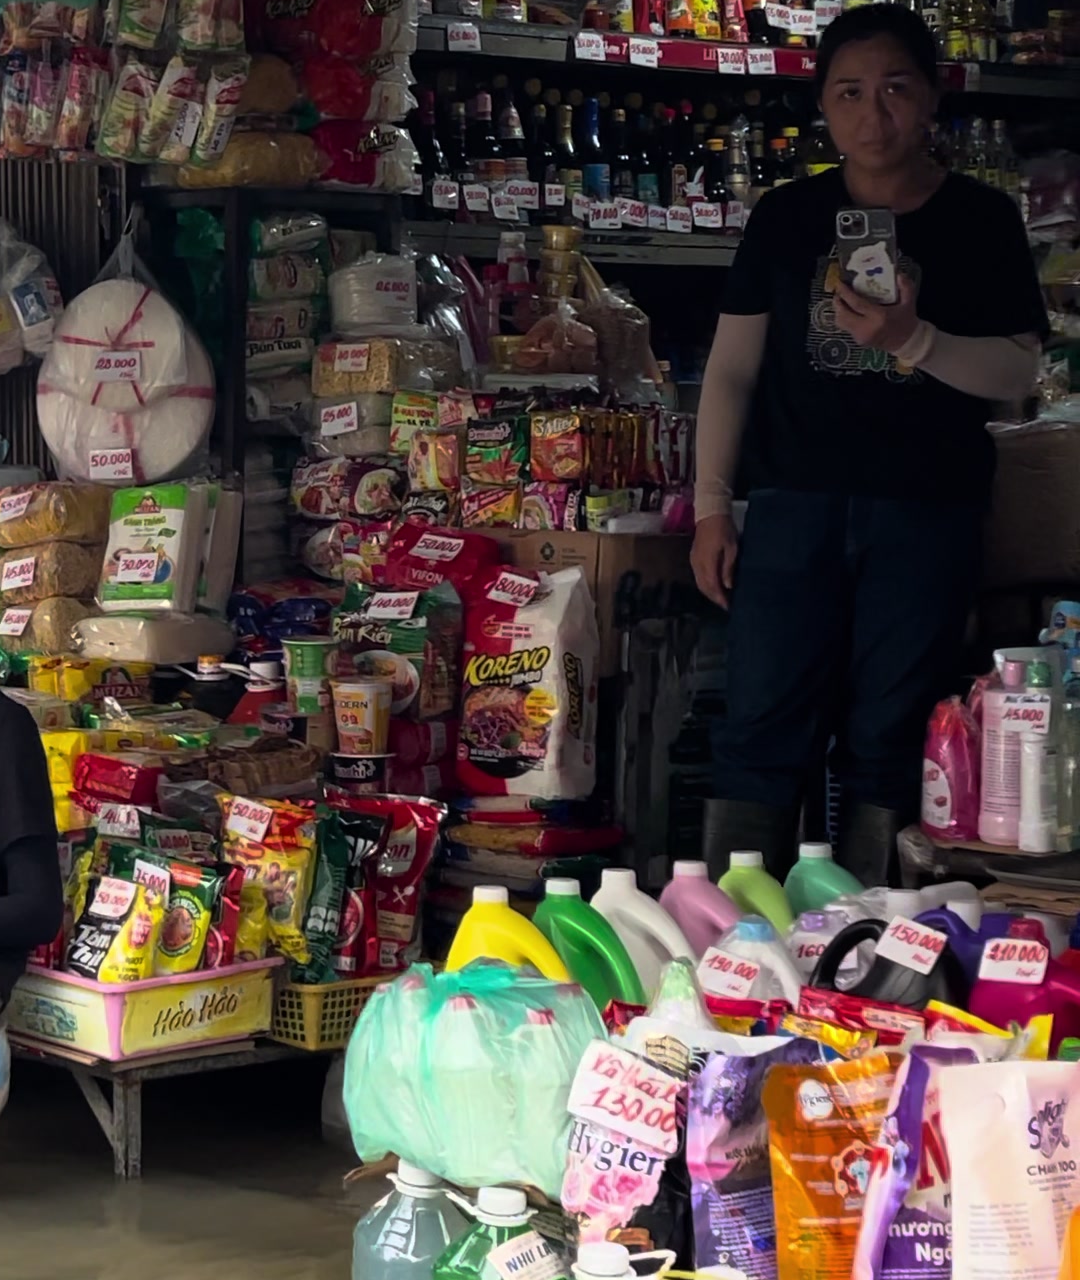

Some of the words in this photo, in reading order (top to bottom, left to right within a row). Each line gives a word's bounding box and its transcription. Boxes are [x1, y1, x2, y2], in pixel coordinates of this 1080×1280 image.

[91, 453, 131, 467] 50.000
[411, 568, 444, 585] VIFON
[464, 646, 552, 687] KORENO
[233, 802, 270, 824] 50.000
[890, 924, 944, 953] 150.000
[153, 1000, 193, 1038] Hảo
[199, 986, 239, 1023] Hảo
